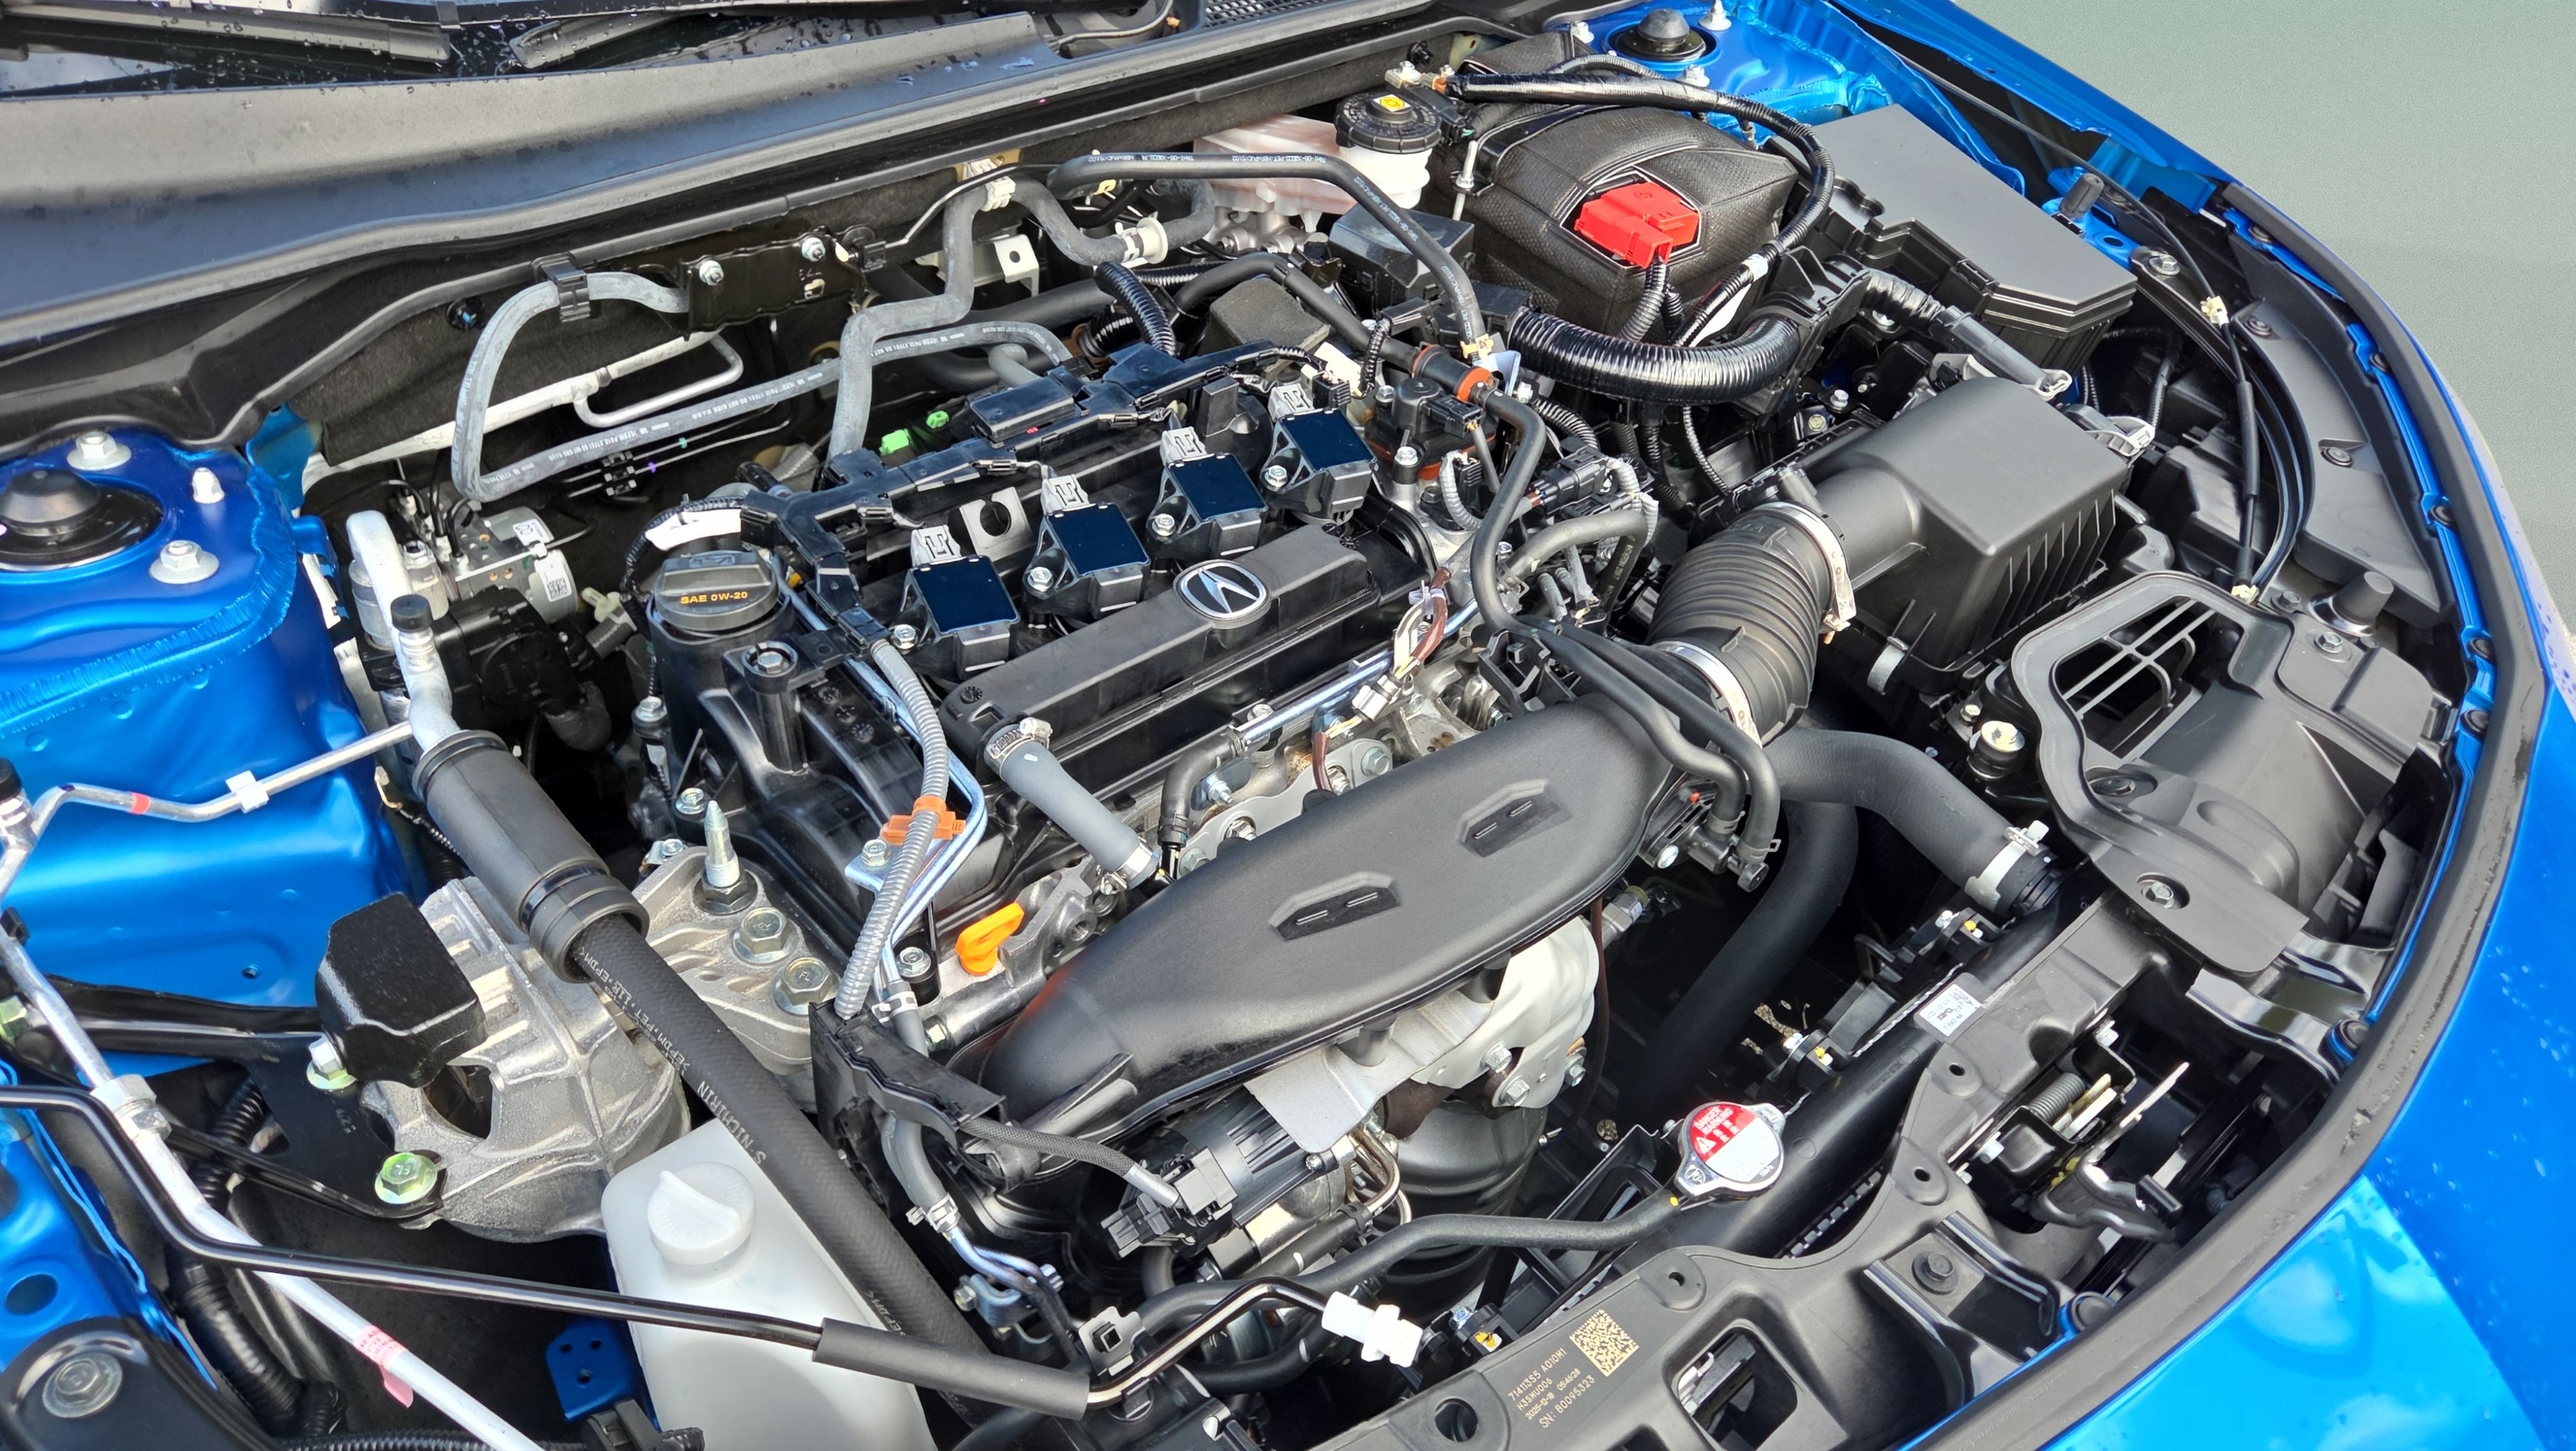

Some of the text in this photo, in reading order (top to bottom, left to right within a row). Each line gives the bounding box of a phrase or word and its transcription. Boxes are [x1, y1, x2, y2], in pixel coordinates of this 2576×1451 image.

[680, 590, 747, 604] SAE 0W-20
[1694, 1105, 1722, 1130] DANGER
[1701, 1106, 1734, 1135] WARNING
[1507, 1347, 1567, 1401] 714113S5 A010M1
